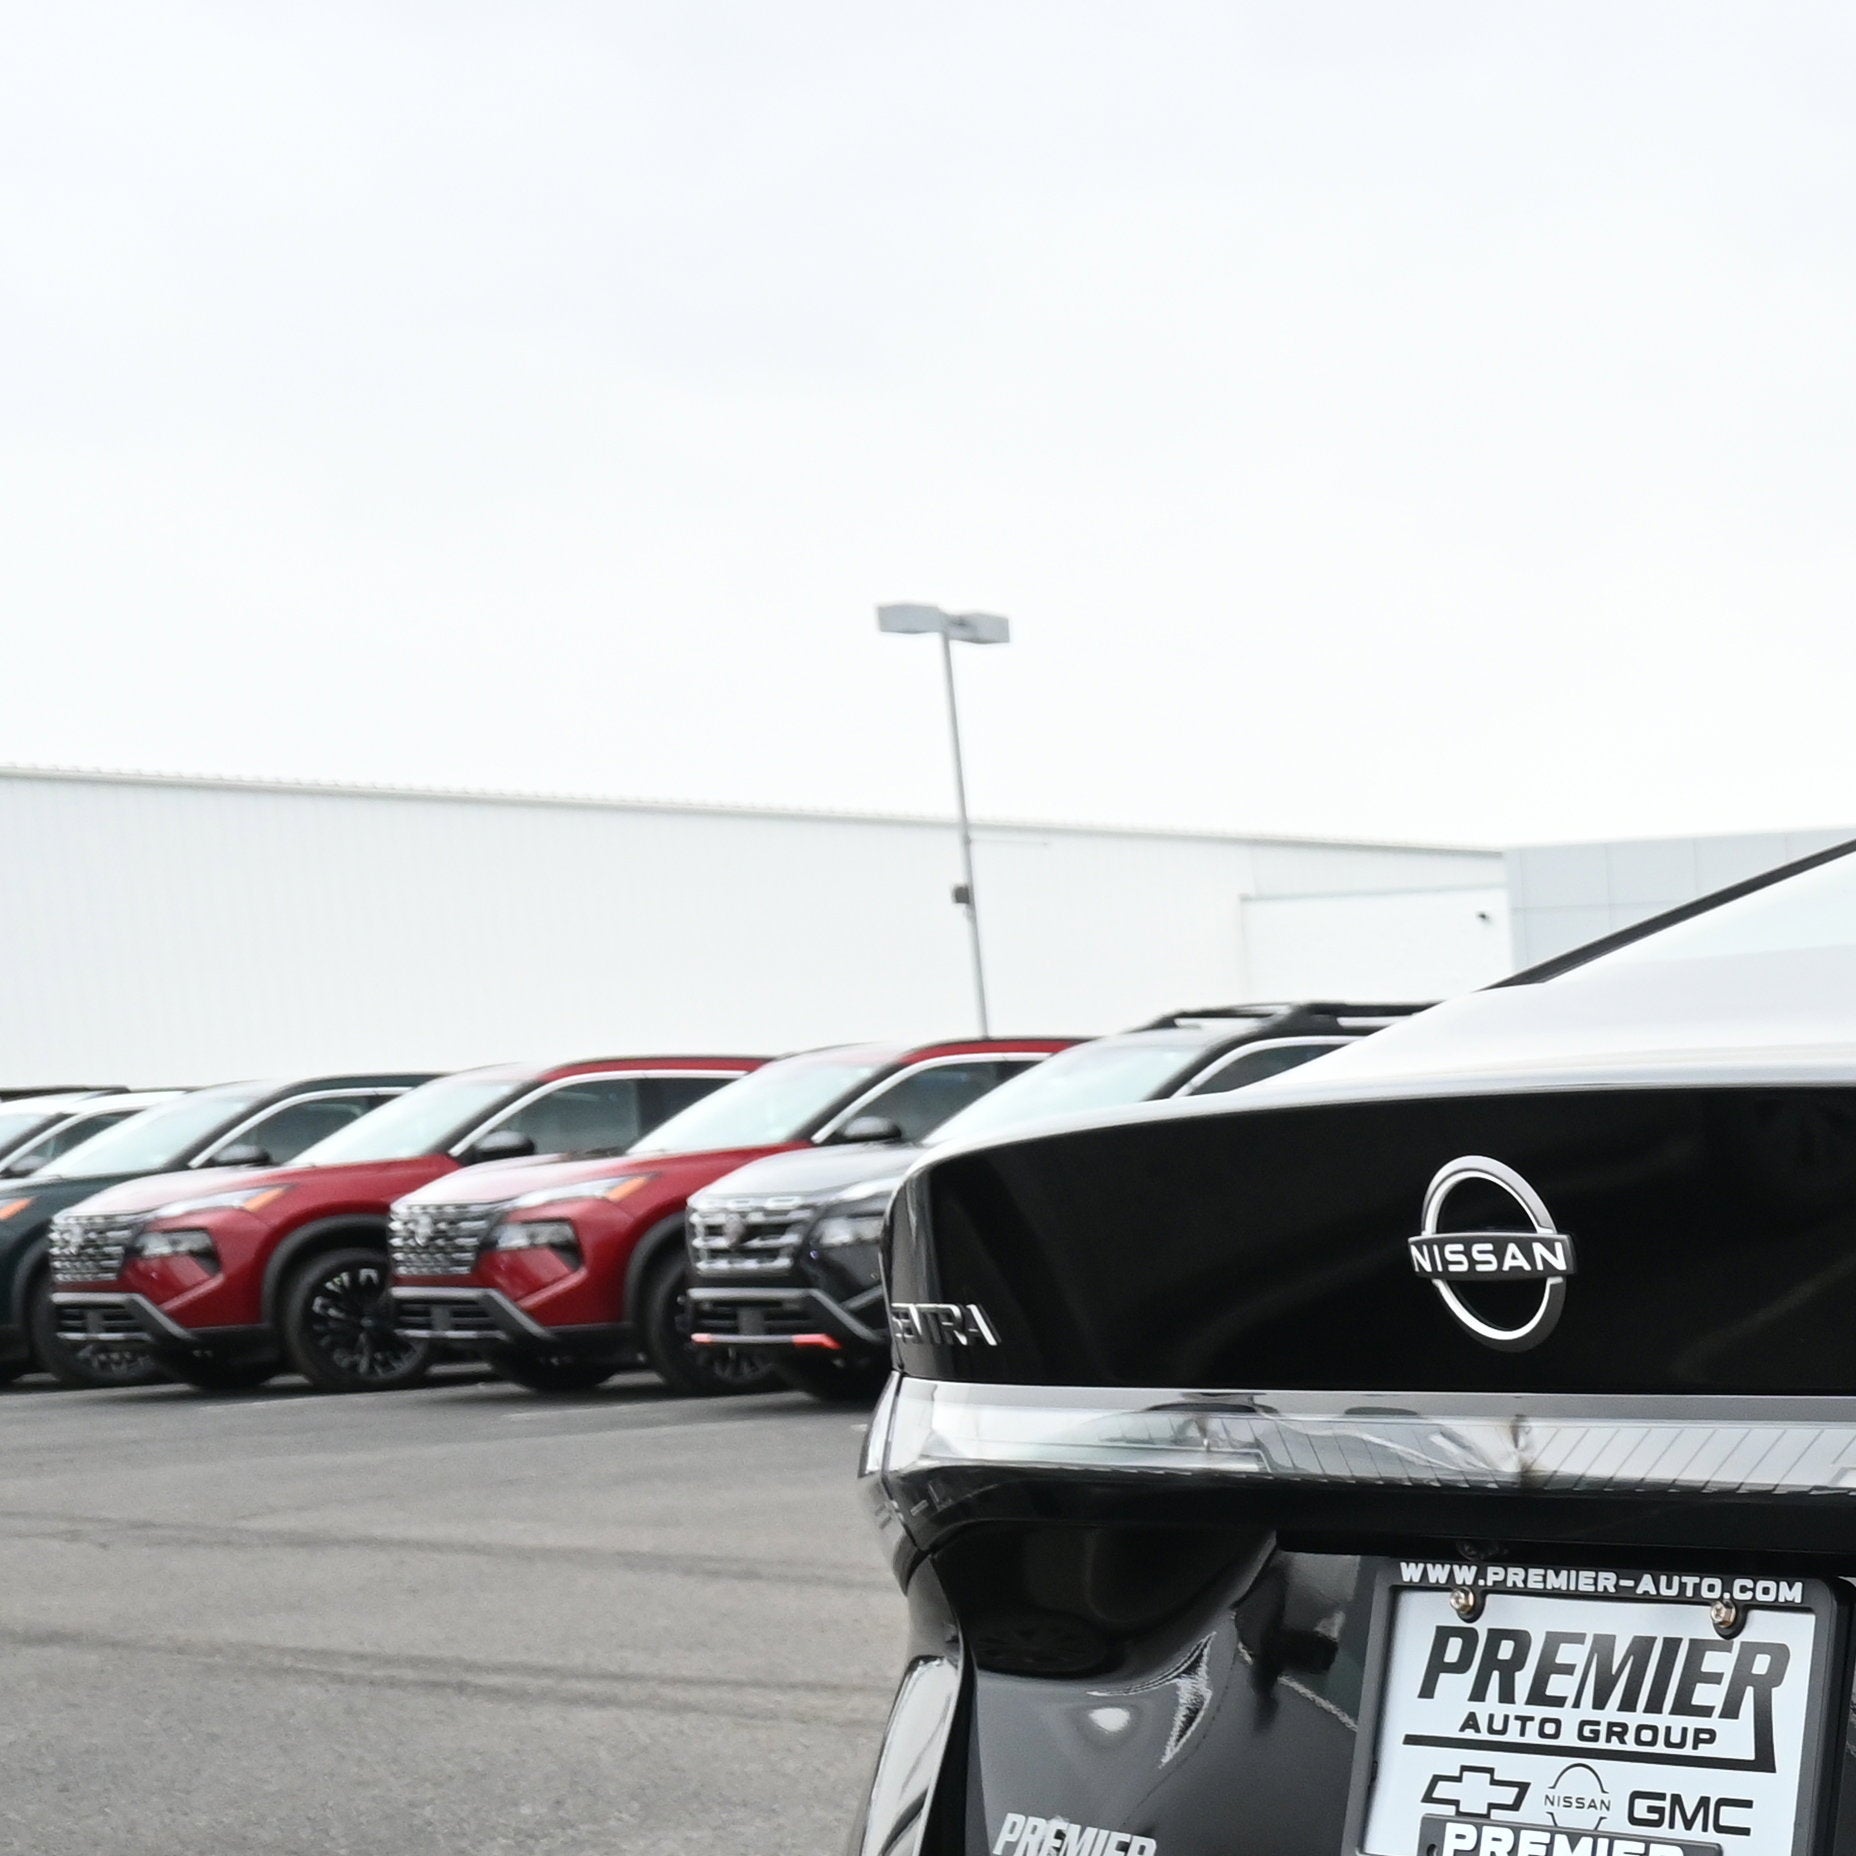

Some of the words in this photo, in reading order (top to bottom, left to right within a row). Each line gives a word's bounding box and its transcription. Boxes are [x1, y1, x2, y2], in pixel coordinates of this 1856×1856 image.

[1410, 1242, 1567, 1272] NISSAN
[1400, 1562, 1803, 1603] WWW.PREMIER-AUTO.COM
[1417, 1625, 1791, 1722] PREMIER
[1458, 1711, 1562, 1741] AUTO
[1577, 1719, 1717, 1751] GROUP
[1544, 1794, 1611, 1813] NISSAN
[1627, 1790, 1754, 1836] GMC
